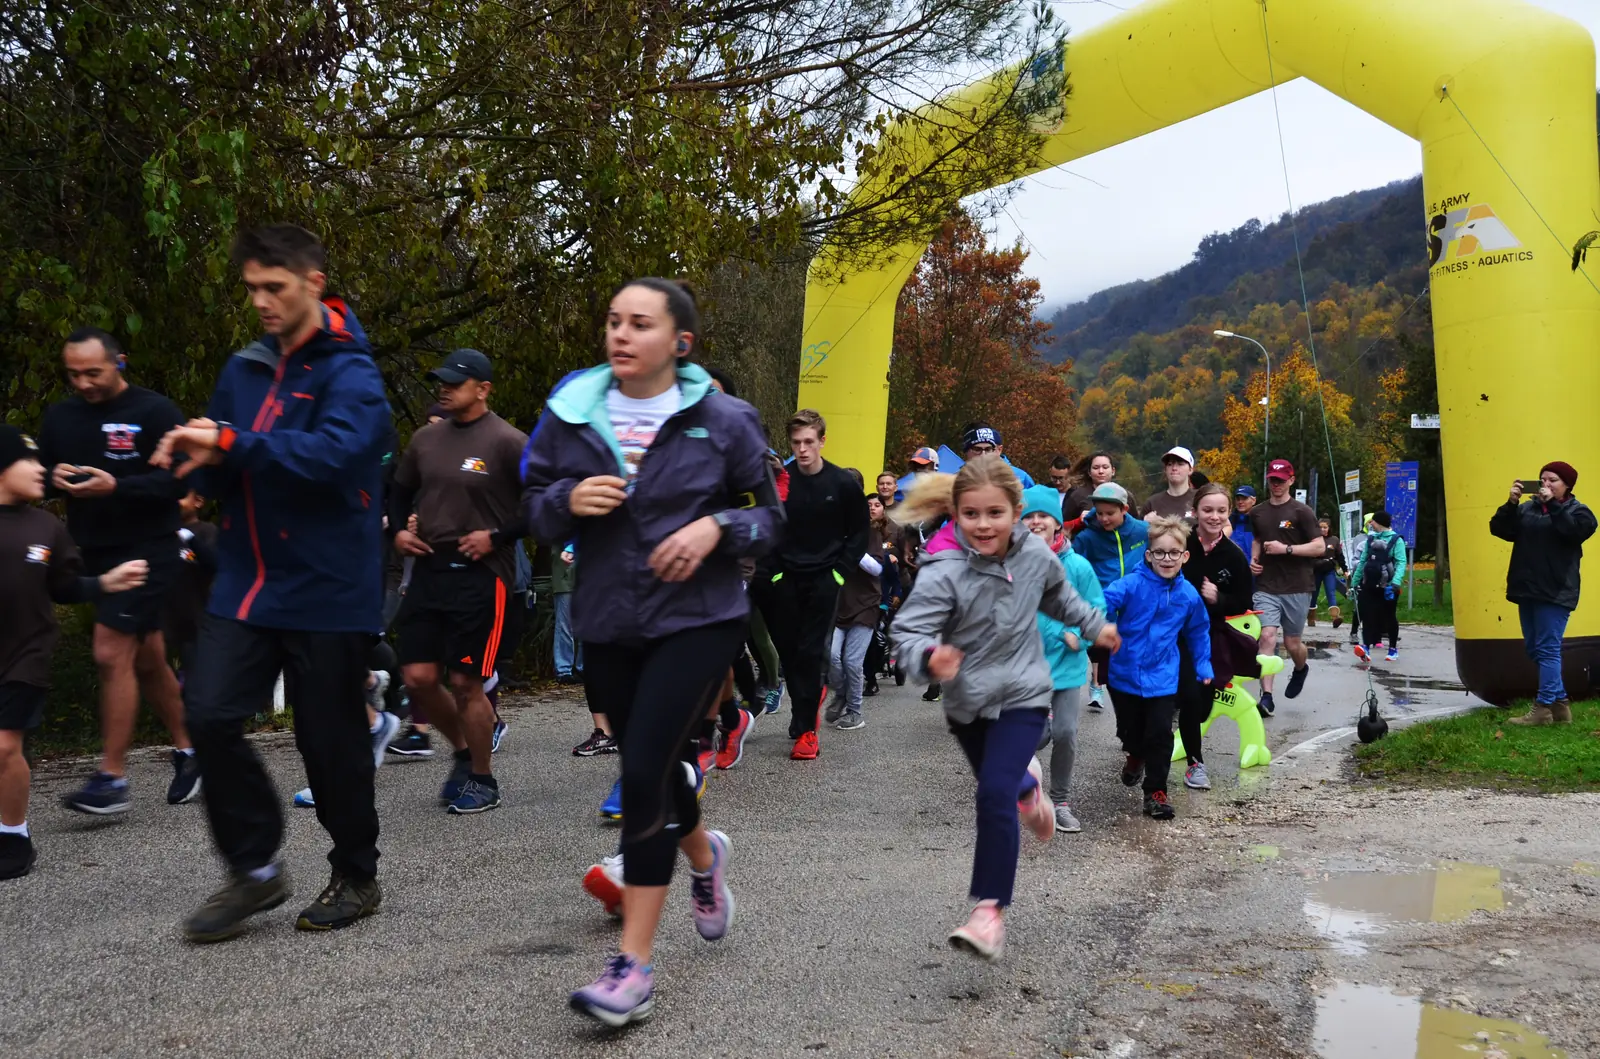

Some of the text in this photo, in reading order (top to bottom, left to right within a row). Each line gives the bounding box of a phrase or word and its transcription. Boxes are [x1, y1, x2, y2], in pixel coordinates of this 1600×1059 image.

[1441, 192, 1470, 208] ARMY
[1436, 261, 1468, 277] FITNESS
[1478, 251, 1534, 267] AQUATICS
